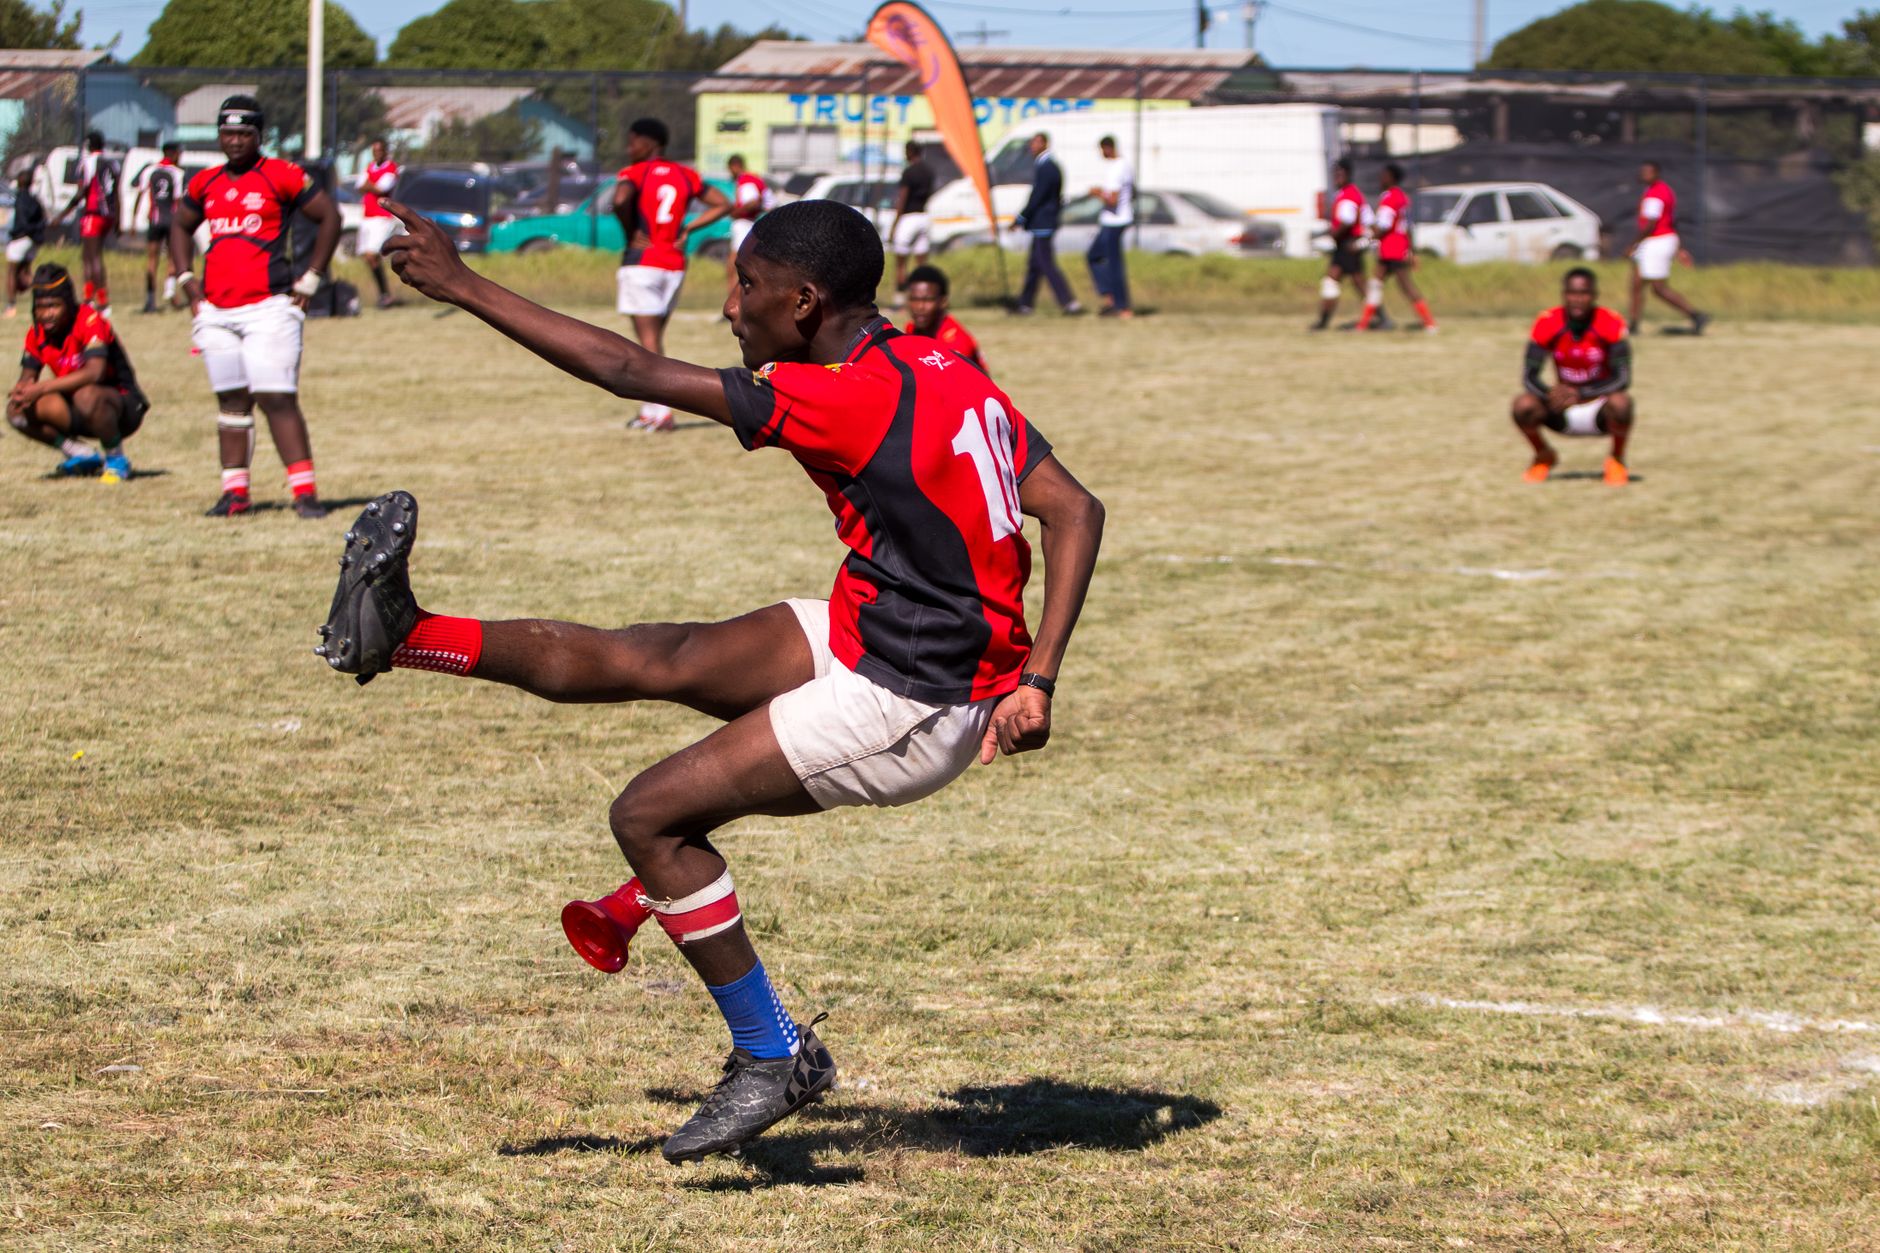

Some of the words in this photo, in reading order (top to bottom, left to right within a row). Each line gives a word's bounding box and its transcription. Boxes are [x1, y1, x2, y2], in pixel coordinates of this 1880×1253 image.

[789, 95, 913, 124] TRUST
[972, 97, 1094, 125] OTOR
[656, 184, 677, 224] 2
[951, 396, 1023, 542] 10
